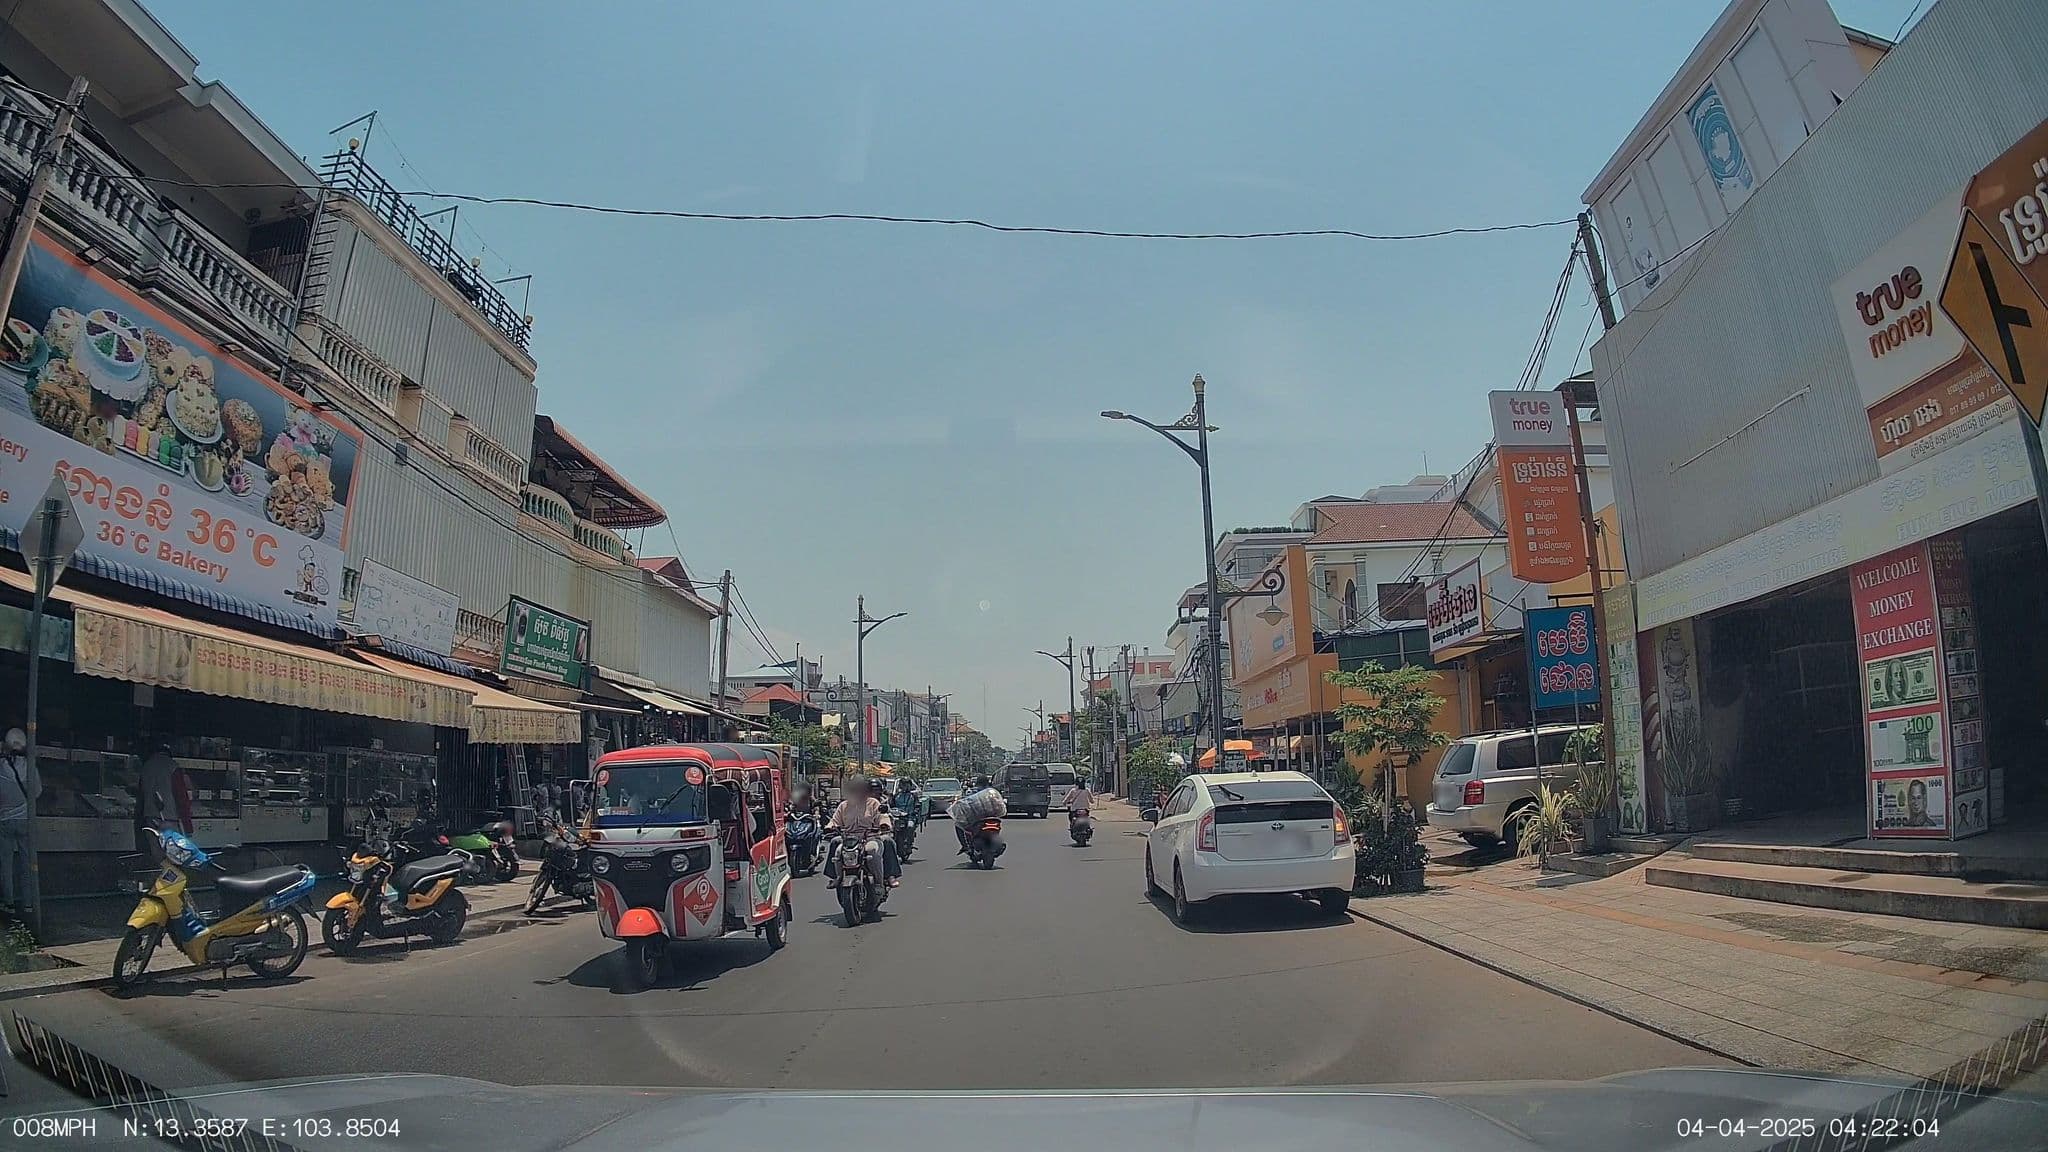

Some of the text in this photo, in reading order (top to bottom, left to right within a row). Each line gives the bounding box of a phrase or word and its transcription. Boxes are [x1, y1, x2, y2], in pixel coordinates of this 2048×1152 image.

[1856, 266, 1922, 326] true
[1869, 301, 1933, 358] money
[1509, 397, 1551, 416] true
[1512, 419, 1553, 434] money
[156, 541, 229, 583] Bakery
[1856, 556, 1921, 590] WELCOME
[1869, 590, 1915, 618] MONEY
[1862, 618, 1934, 650] EXCHANGE
[1911, 715, 1934, 733] 100
